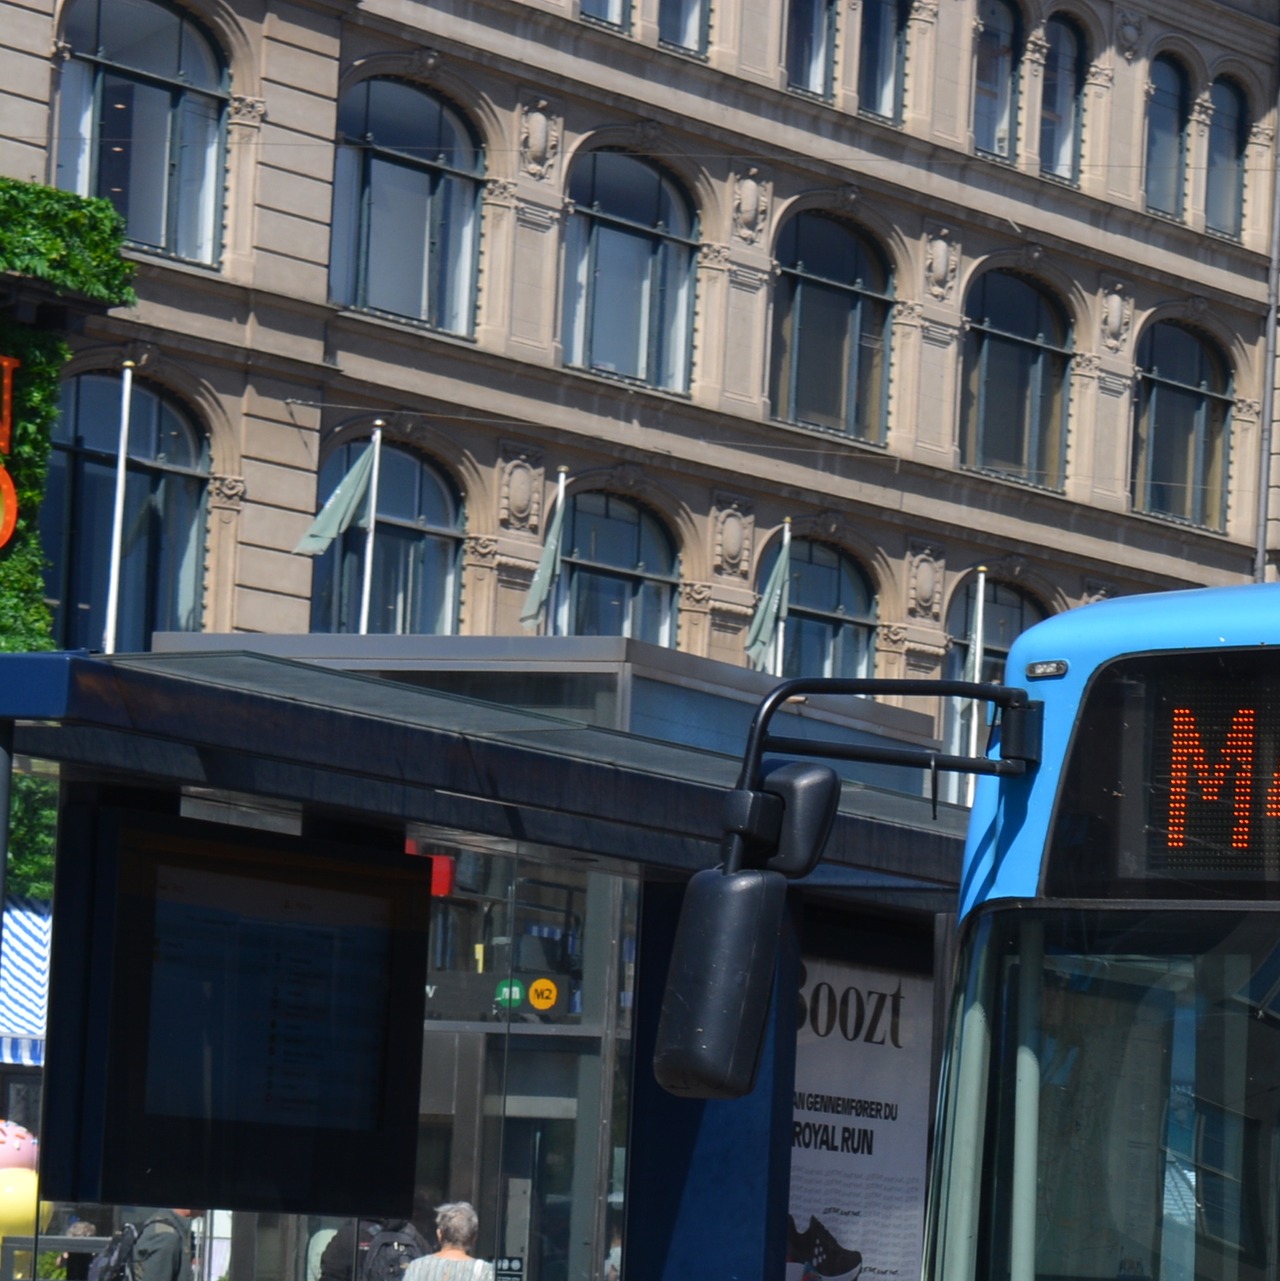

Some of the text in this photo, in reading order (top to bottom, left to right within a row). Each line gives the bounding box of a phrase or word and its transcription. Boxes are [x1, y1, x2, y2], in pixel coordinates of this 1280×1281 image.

[534, 988, 553, 1001] M2
[806, 1093, 882, 1120] GENNEMFØRER
[883, 1102, 898, 1121] DU
[793, 1121, 874, 1155] ROYAL RUN
